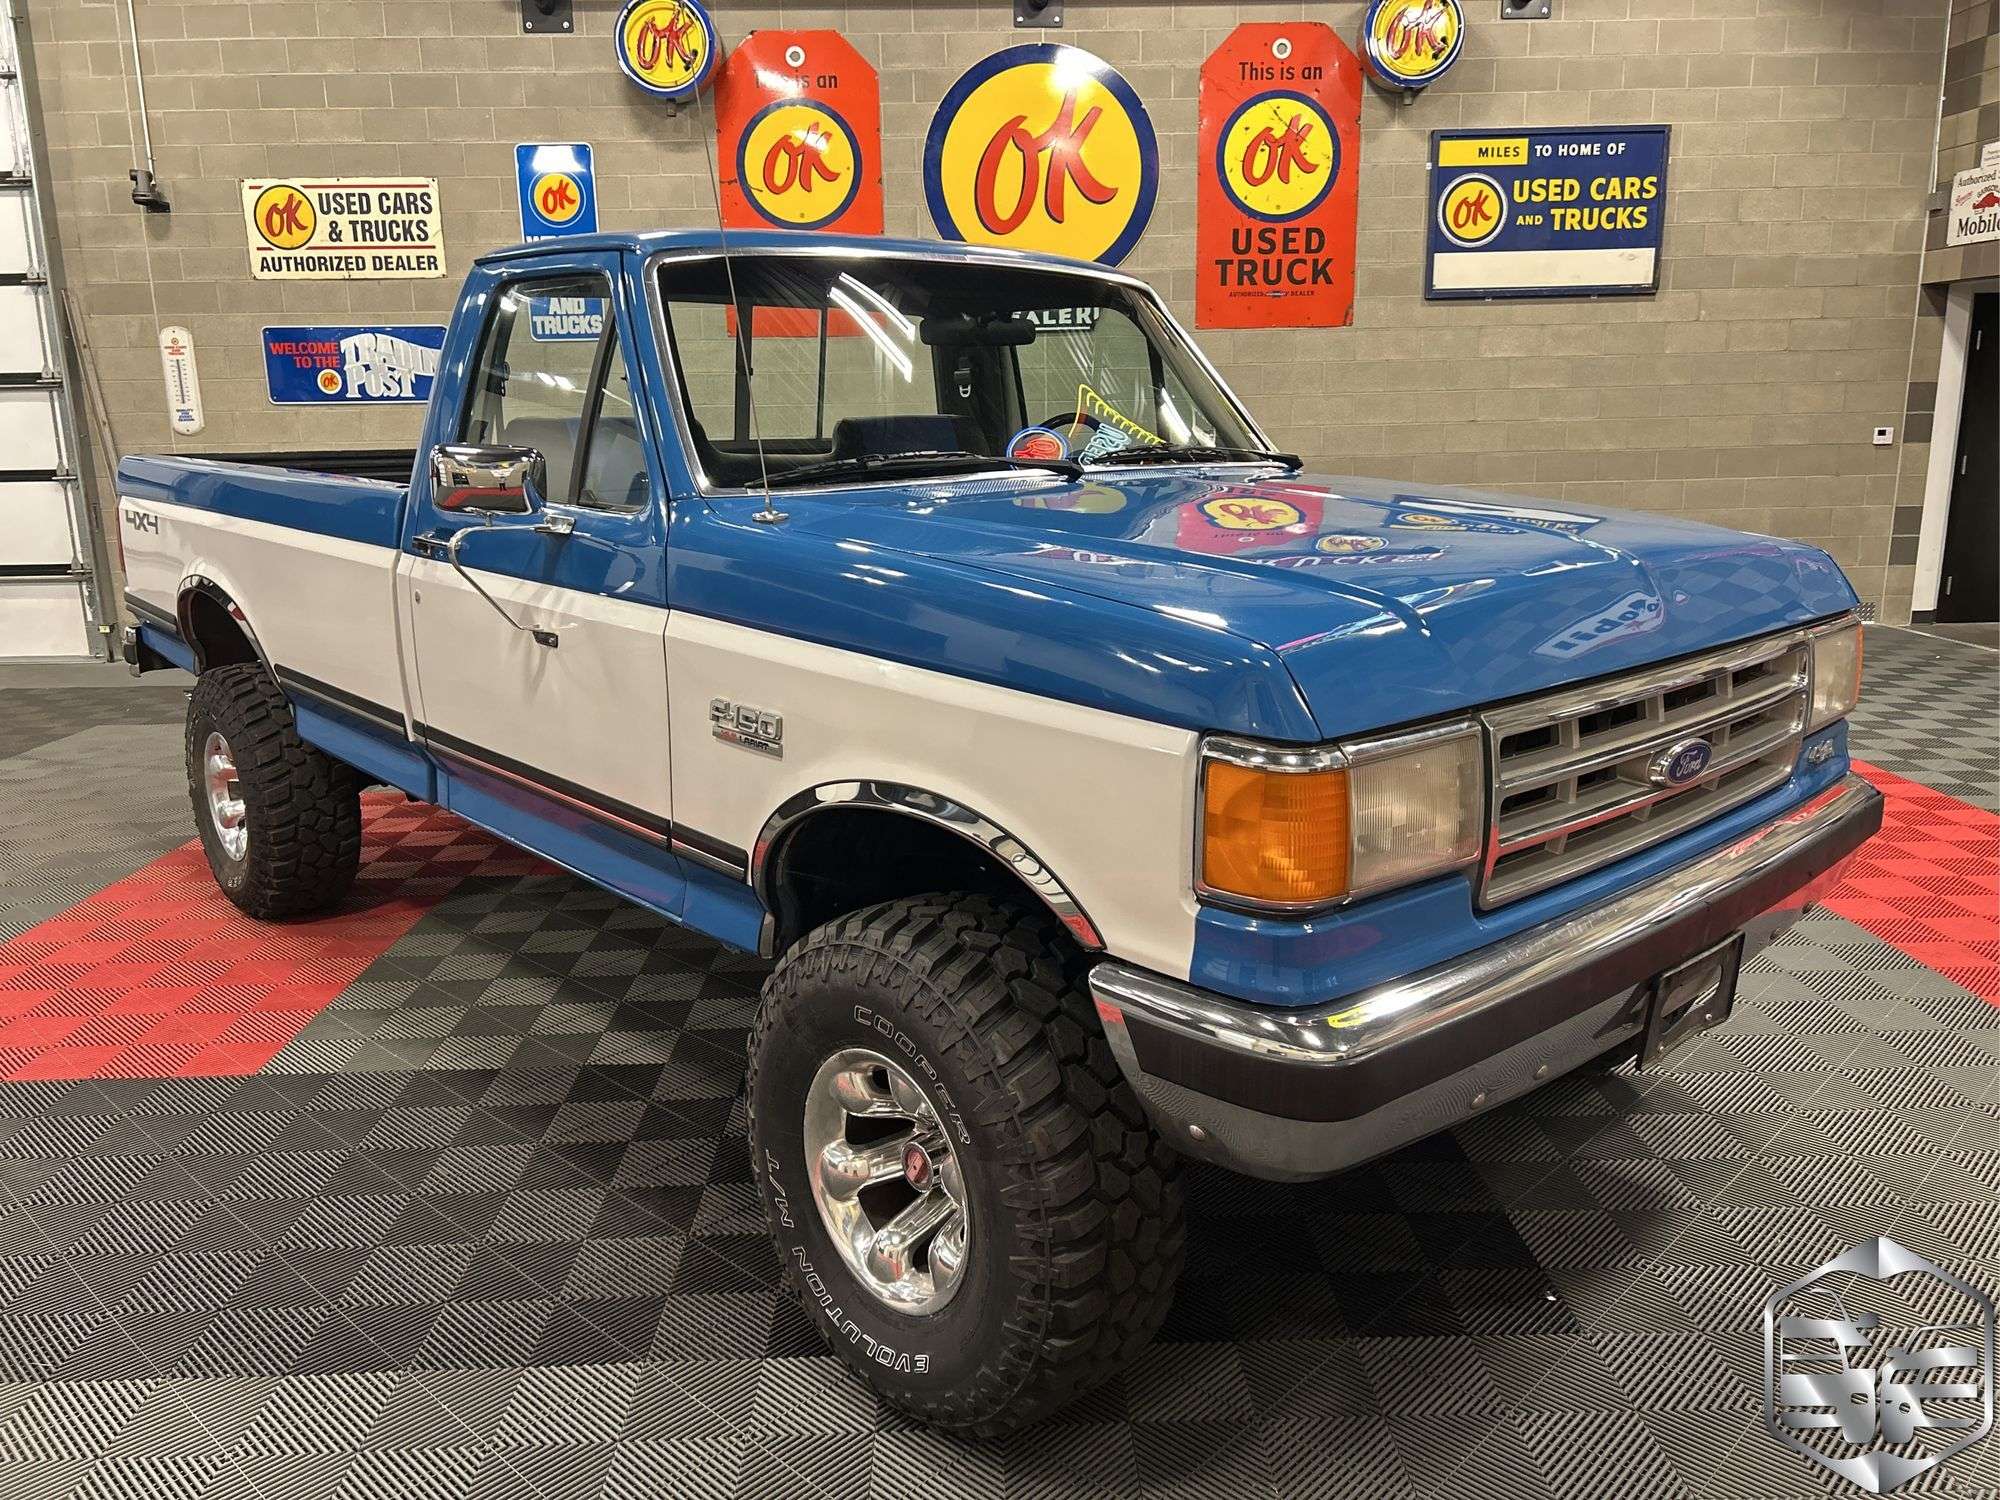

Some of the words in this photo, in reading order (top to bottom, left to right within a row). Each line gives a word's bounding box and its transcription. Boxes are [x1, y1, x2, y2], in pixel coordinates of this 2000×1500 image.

[637, 2, 696, 71] OK
[1386, 0, 1447, 60] OK
[817, 74, 838, 88] an
[1238, 62, 1275, 81] This
[1280, 62, 1295, 81] is
[1301, 66, 1323, 80] an
[763, 121, 841, 195] OK
[975, 84, 1119, 235] OK
[1242, 112, 1319, 187] OK
[1478, 146, 1520, 158] MILES
[1534, 144, 1552, 157] TO
[1558, 143, 1601, 156] HOME
[1606, 142, 1626, 155] OF
[318, 192, 372, 215] USED
[378, 191, 433, 215] CARS
[542, 179, 576, 214] OK
[1512, 178, 1581, 203] USED
[1590, 176, 1658, 201] CARS
[265, 192, 309, 237] OK
[1453, 189, 1493, 229] OK
[1516, 215, 1544, 226] AND
[1550, 206, 1648, 231] TRUCKS
[328, 220, 343, 242] &
[348, 219, 429, 242] TRUCKS
[1231, 227, 1326, 255] USED
[260, 255, 366, 272] AUTHORIZED
[372, 255, 439, 271] DEALER
[1214, 258, 1334, 286] TRUCK
[549, 297, 586, 315] AND
[532, 314, 603, 335] TRUCKS
[269, 341, 339, 355] WELCOME
[294, 356, 312, 369] TO
[315, 355, 341, 368] THE
[340, 333, 442, 376] TRADIN
[322, 374, 338, 388] OK
[344, 363, 416, 398] POST
[1676, 749, 1704, 777] Ford
[853, 1004, 971, 1146] COOPER
[765, 1149, 795, 1229] M/T
[791, 1246, 930, 1374] EVOLUTION
